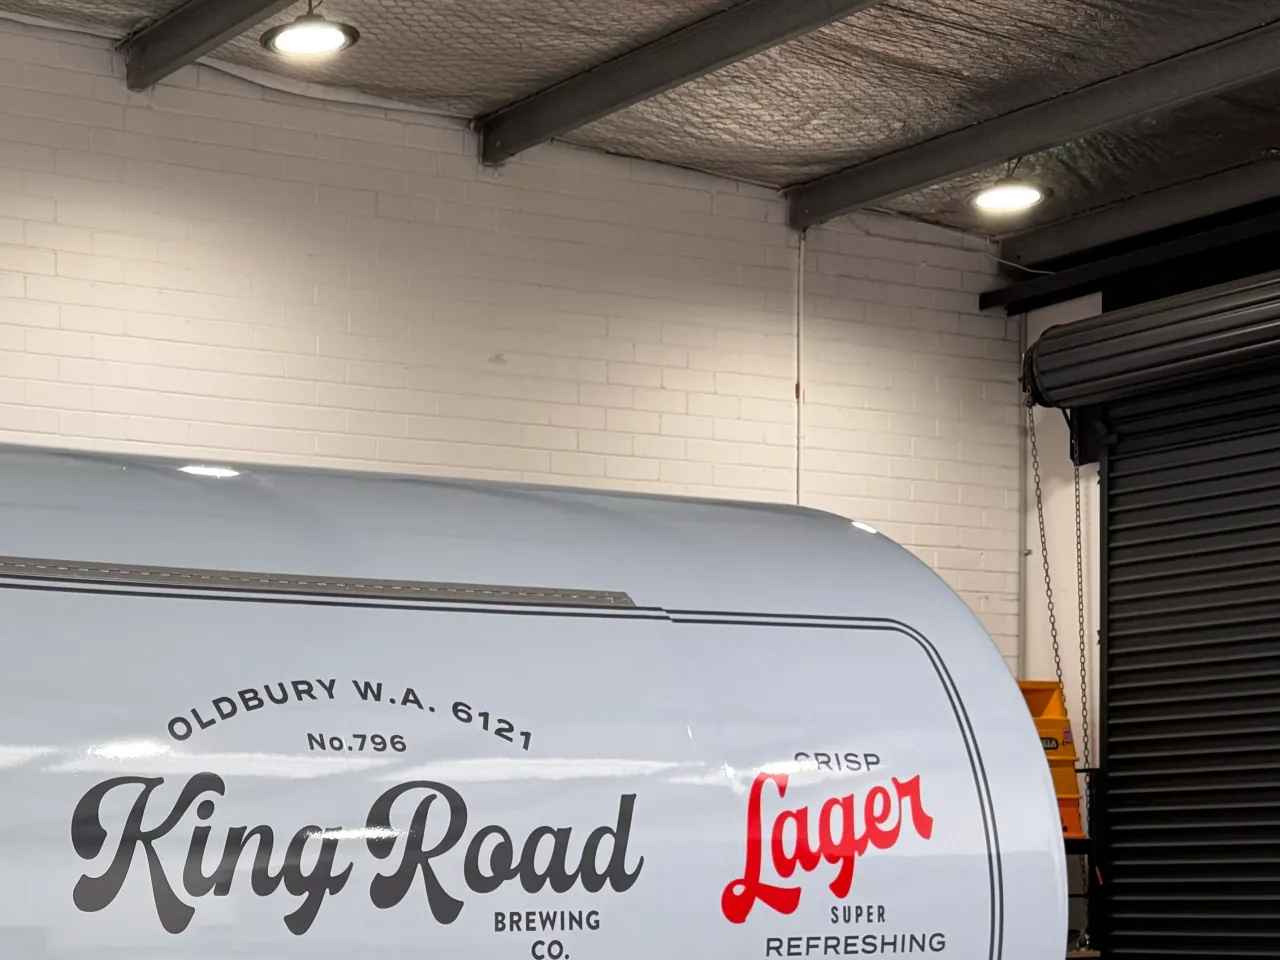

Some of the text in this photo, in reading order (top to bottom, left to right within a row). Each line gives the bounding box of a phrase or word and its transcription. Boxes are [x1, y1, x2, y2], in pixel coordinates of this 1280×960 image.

[168, 678, 532, 751] OLDBURY W.A. 6121
[306, 732, 408, 752] No.796
[70, 771, 645, 936] King Road
[721, 771, 934, 924] Lager
[493, 910, 601, 933] BREWING
[830, 905, 886, 923] SUPER
[531, 939, 571, 960] CO.
[765, 932, 947, 957] REFRESHING
